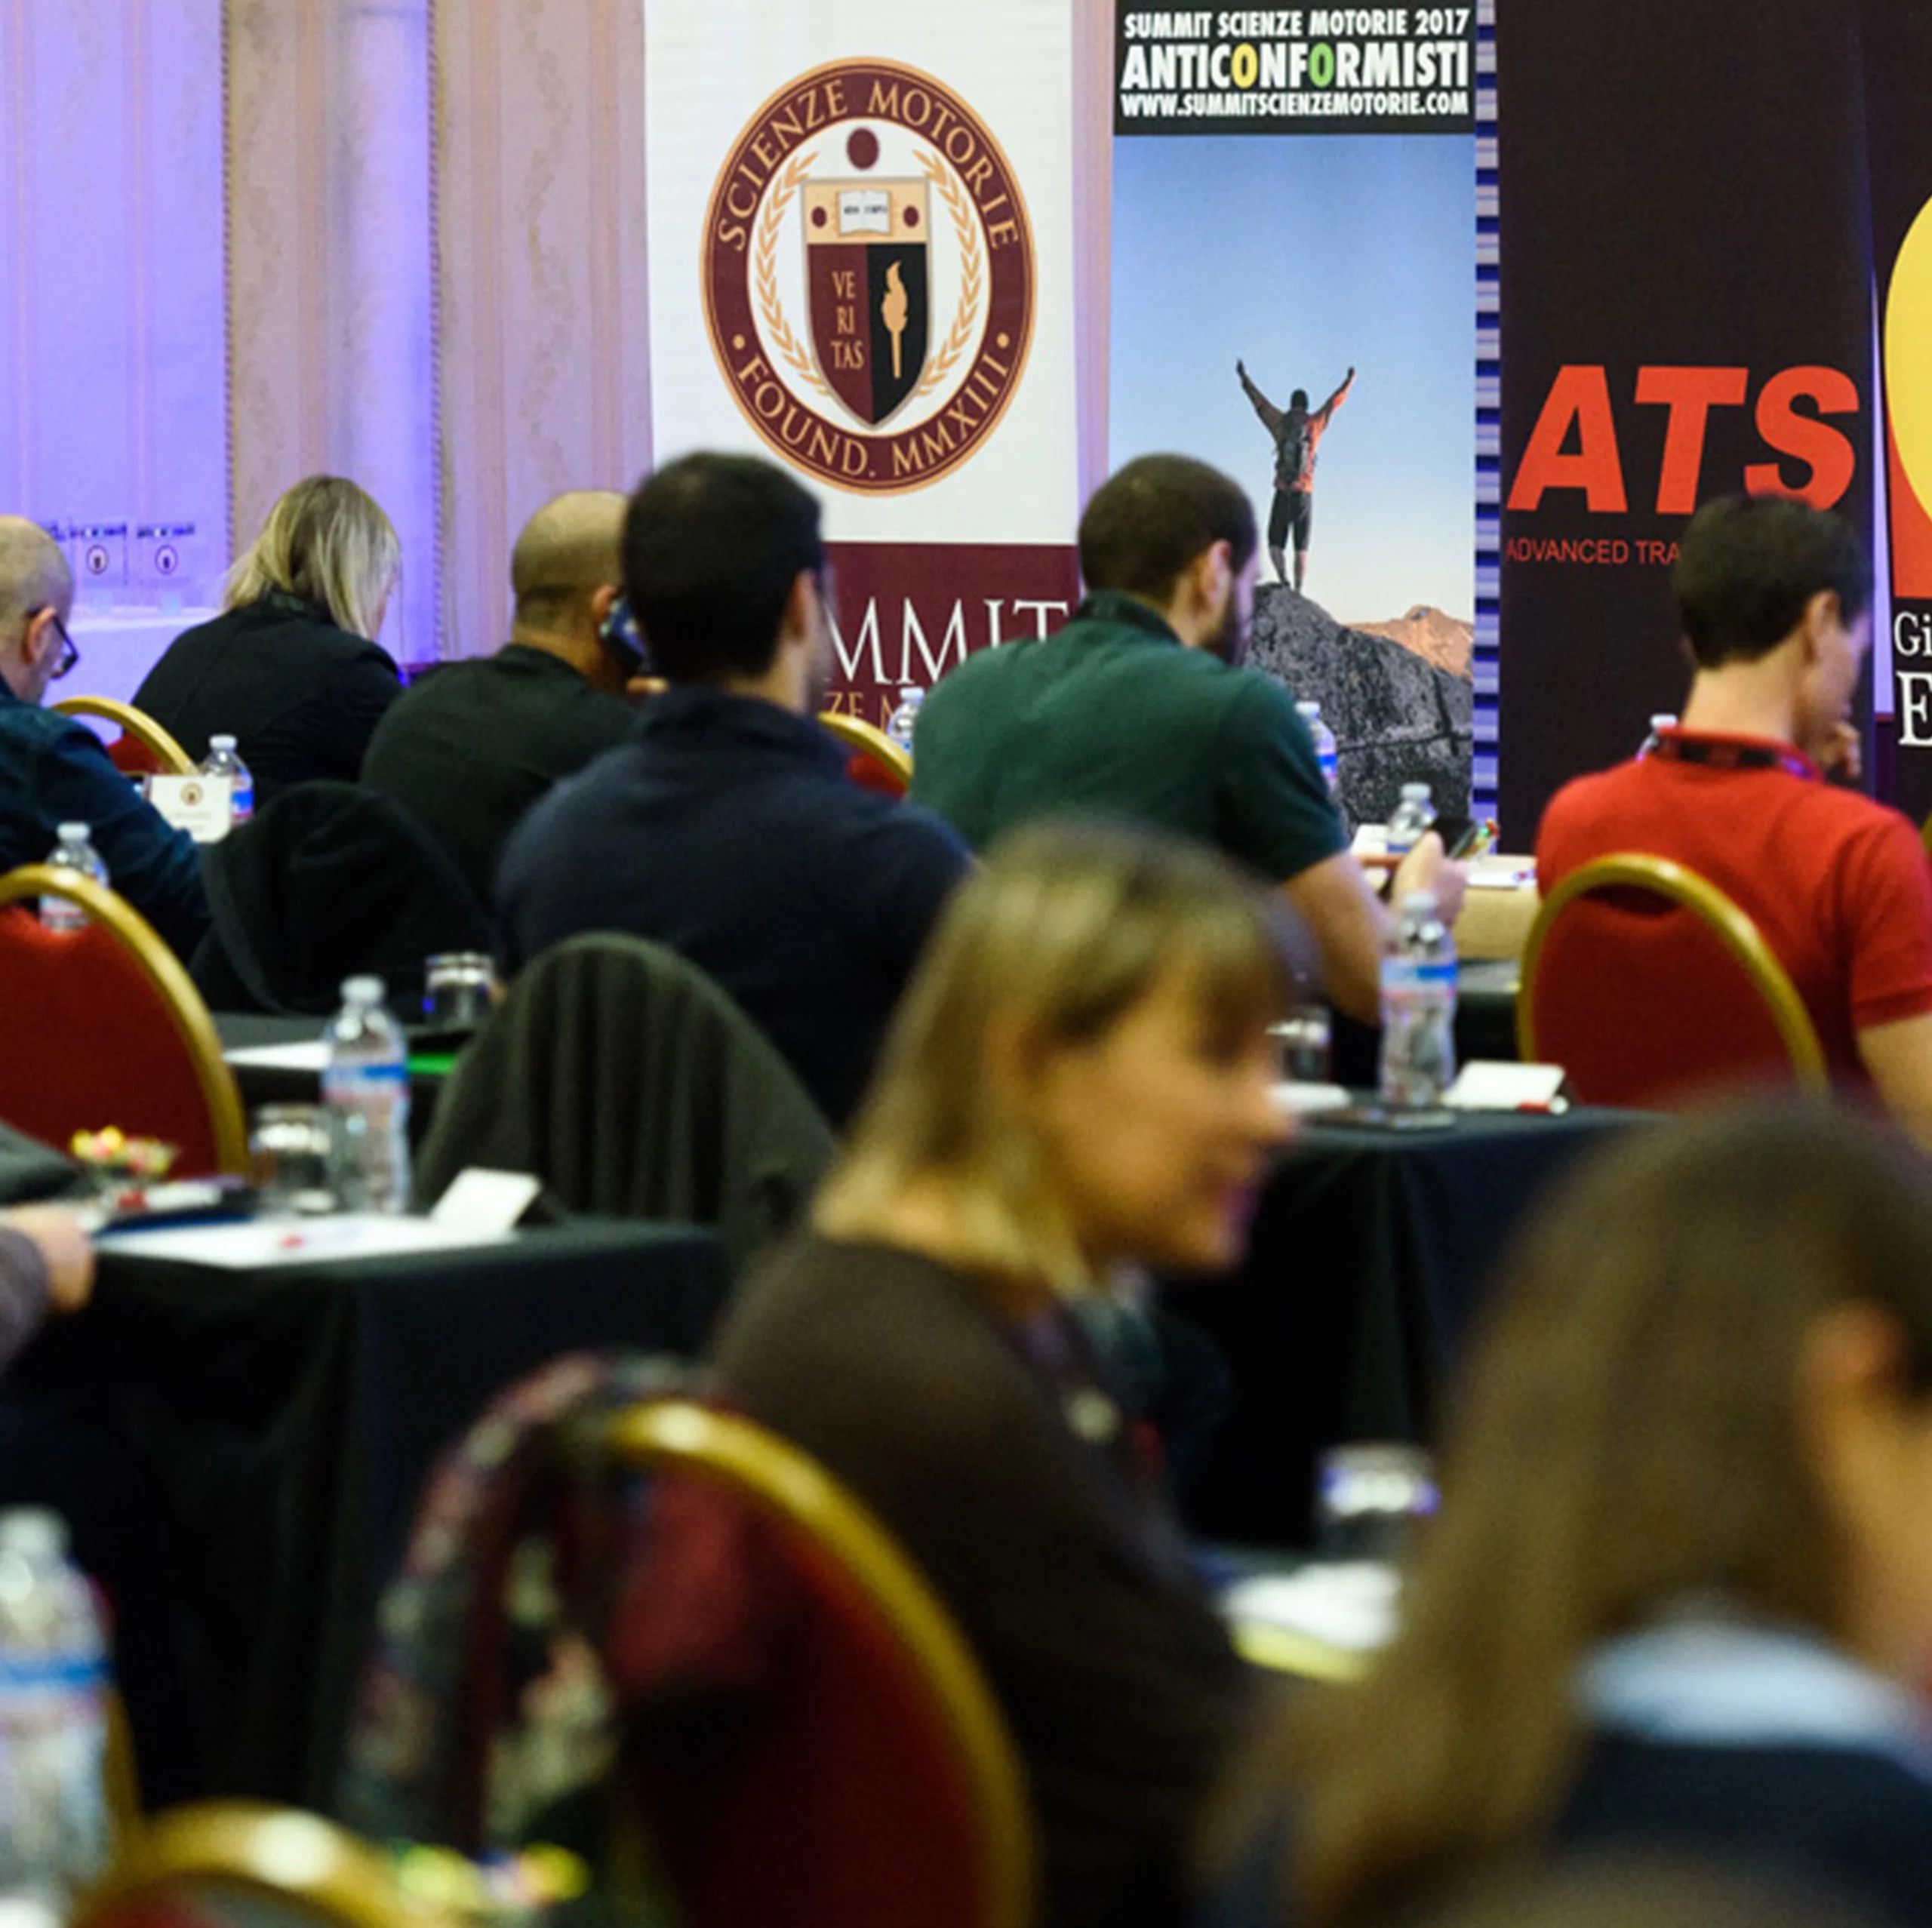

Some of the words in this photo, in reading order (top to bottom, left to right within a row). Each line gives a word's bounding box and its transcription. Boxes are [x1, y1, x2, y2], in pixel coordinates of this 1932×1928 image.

[1124, 13, 1211, 38] SUMMIT
[1217, 11, 1303, 36] SCIENZE
[1309, 10, 1409, 36] MOTORIE
[1415, 9, 1470, 35] 2017
[1121, 42, 1469, 89] ANTICONFORMISTI
[1121, 92, 1469, 116] WWW.SUMMITSCIENZEMOTORIE.COM
[718, 79, 848, 251] SCIENZE
[867, 80, 1019, 250] MOTORIE
[831, 270, 856, 299] VE
[836, 305, 855, 334] RI
[830, 340, 865, 370] TAS
[737, 355, 876, 478] FOUND.
[892, 352, 1009, 477] MMXIII
[1506, 365, 1860, 515] ATS
[1506, 537, 1629, 564] ADVANCED
[1635, 540, 1681, 566] TRA
[828, 596, 1069, 684] MMIT
[1894, 611, 1932, 657] Gi
[1896, 671, 1932, 746] E
